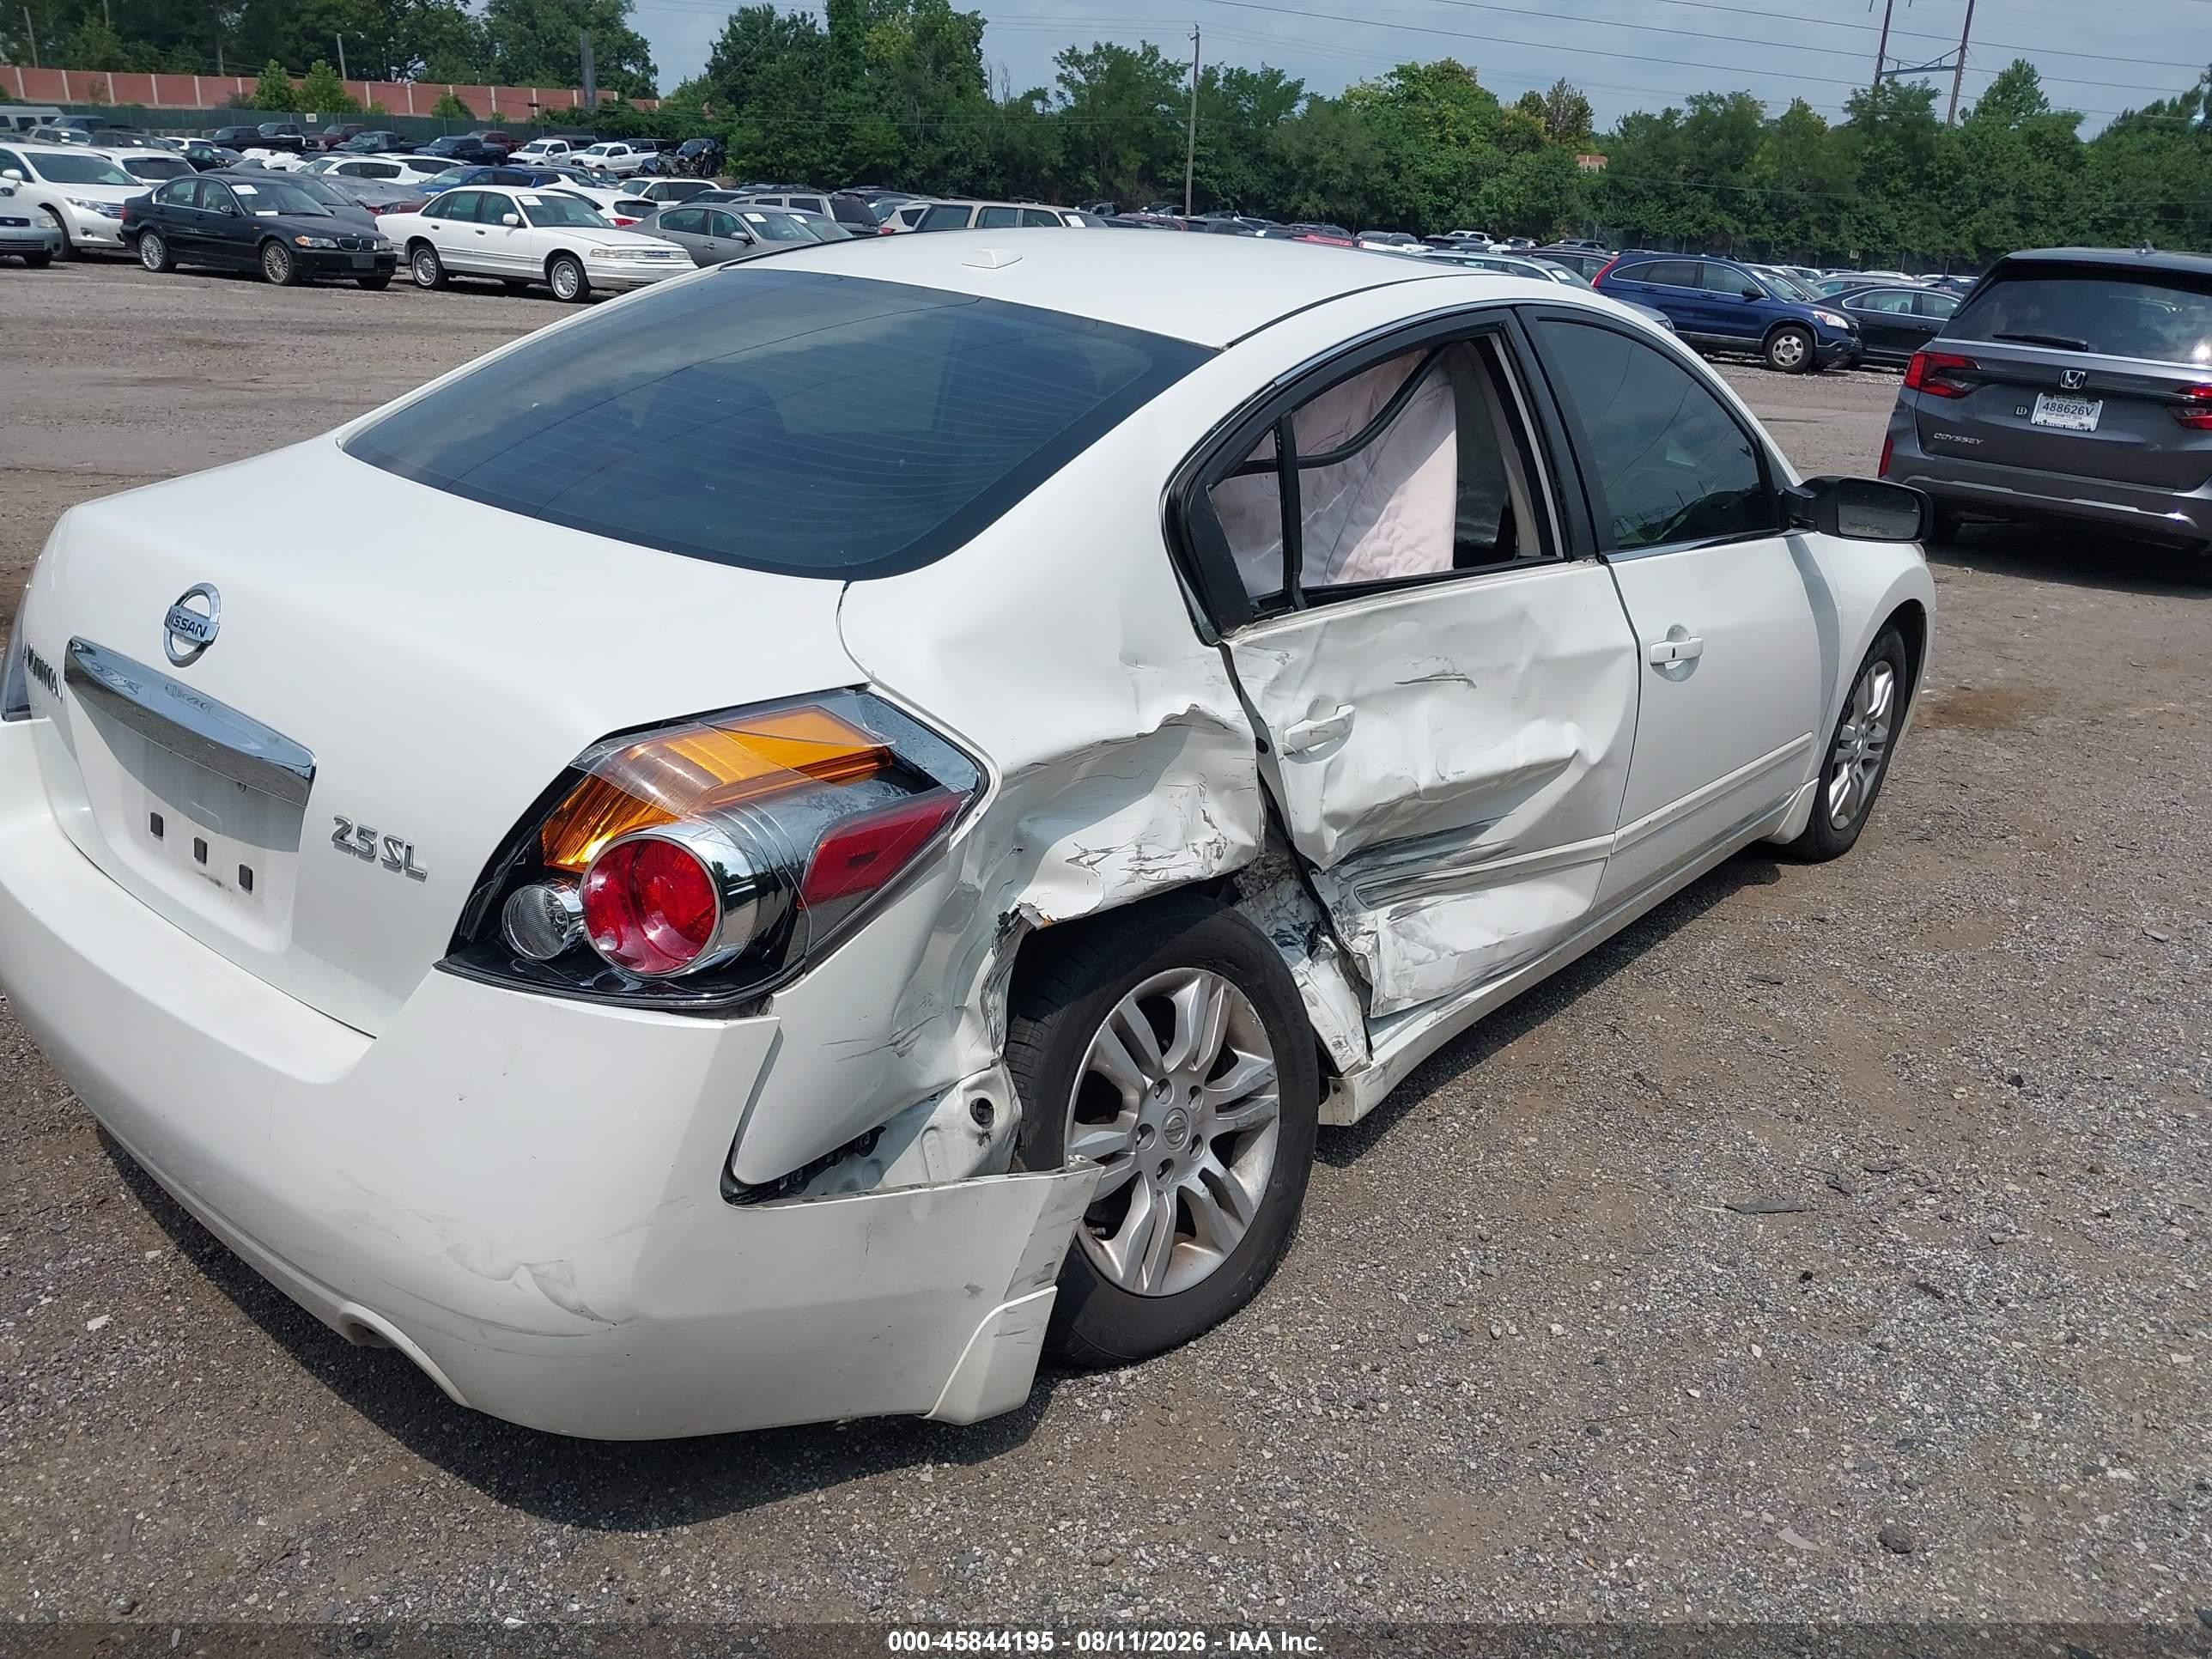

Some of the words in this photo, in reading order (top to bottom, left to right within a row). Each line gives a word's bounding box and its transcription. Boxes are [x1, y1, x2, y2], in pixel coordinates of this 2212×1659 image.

[2043, 402, 2095, 416] 488626V
[1934, 432, 1984, 445] ODYSSEY
[166, 610, 208, 638] NISSAN
[380, 834, 428, 878] SL
